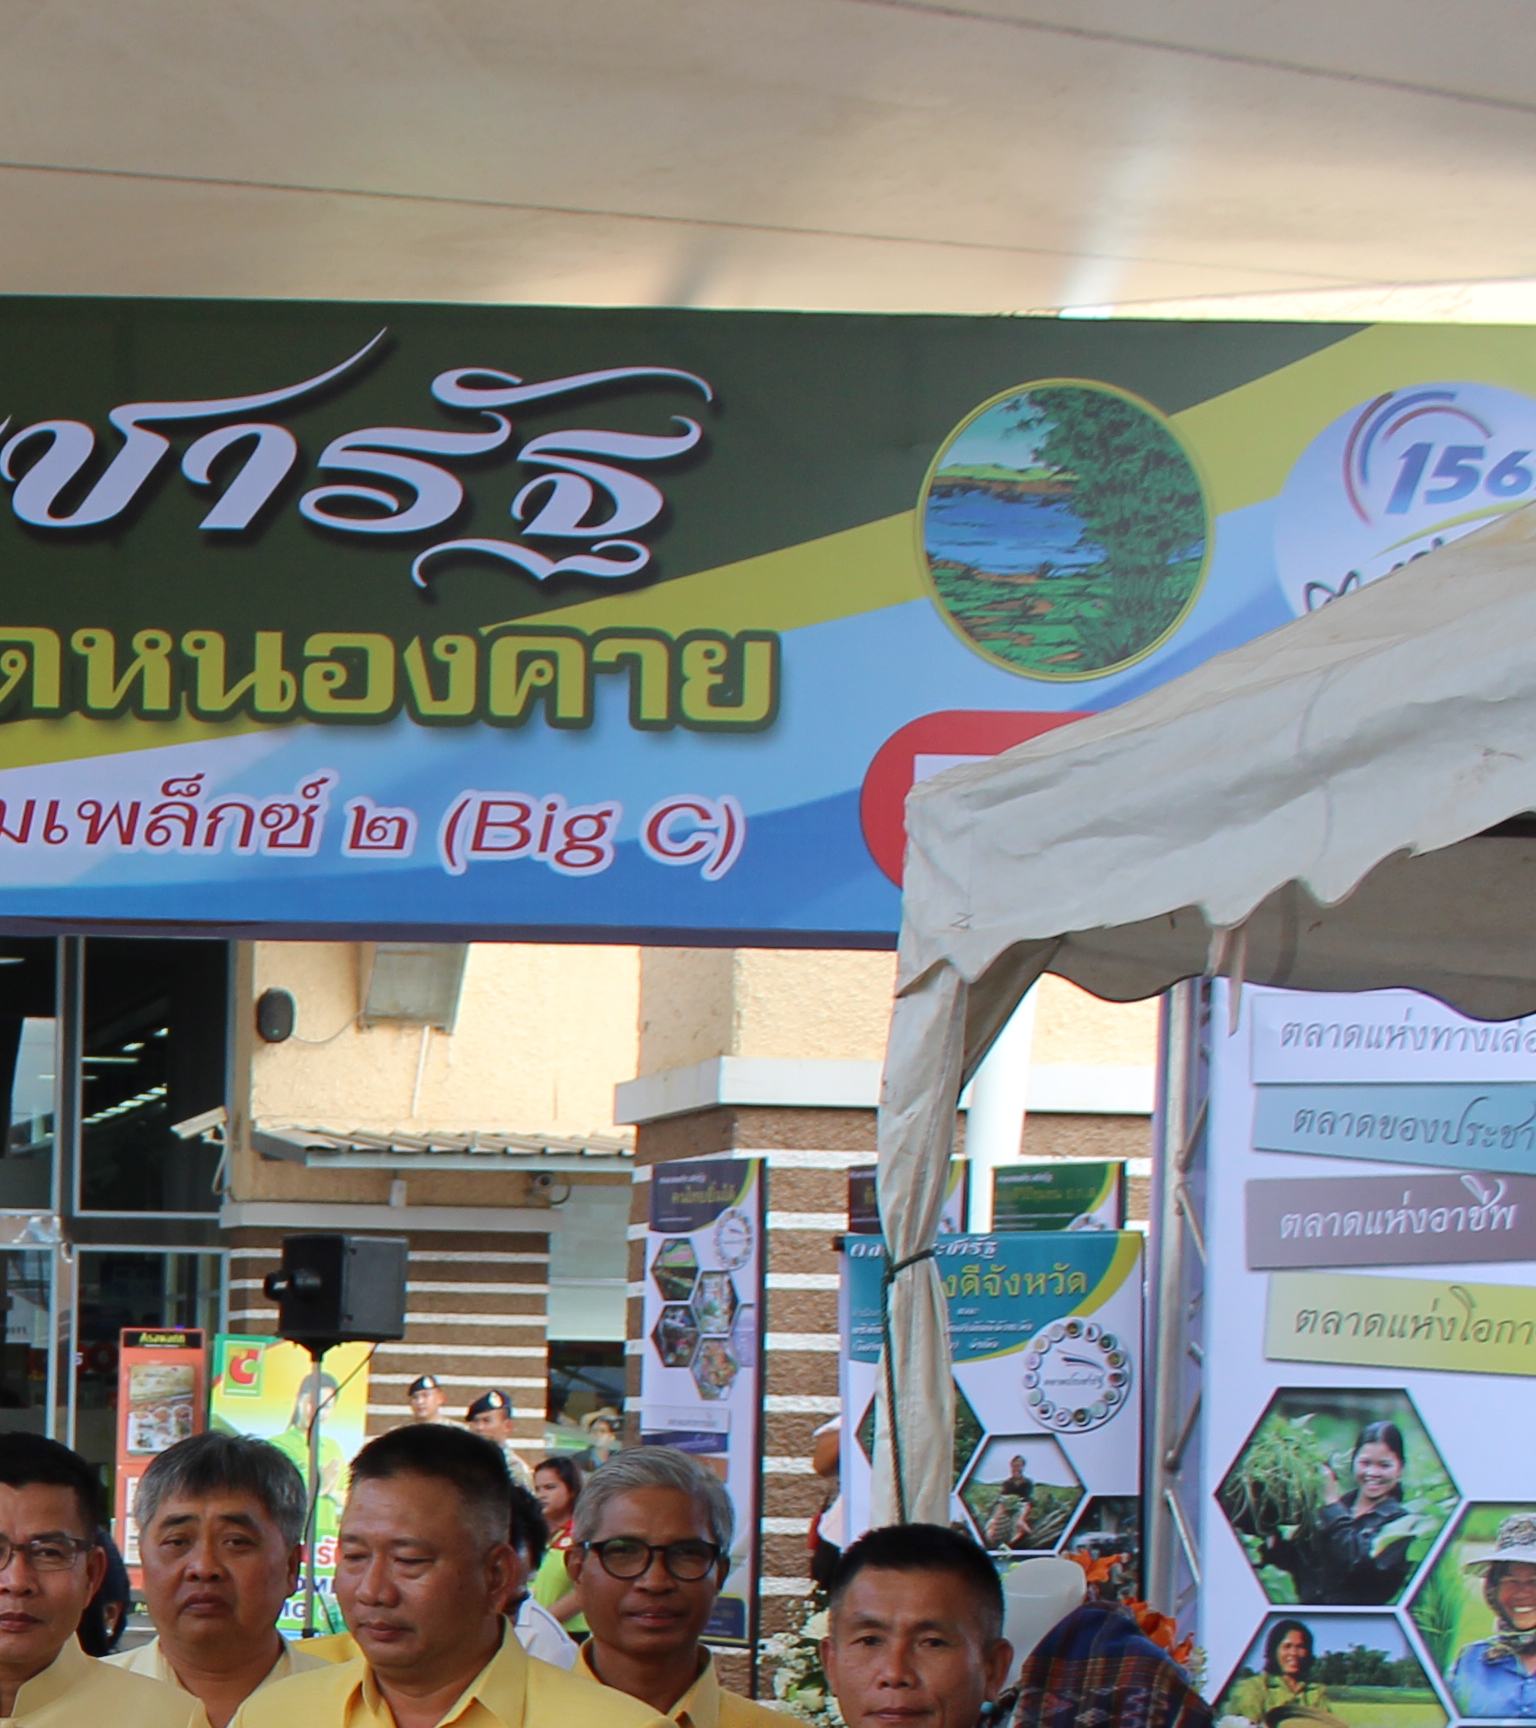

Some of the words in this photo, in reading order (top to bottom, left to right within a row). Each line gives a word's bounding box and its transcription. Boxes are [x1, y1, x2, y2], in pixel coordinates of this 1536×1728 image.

[1385, 441, 1536, 515] 156
[342, 799, 414, 856] ๒
[440, 792, 617, 873] (Big
[642, 795, 746, 880] C)
[1280, 1007, 1536, 1054] ตลาดแห่งทางเลอ
[1293, 1096, 1536, 1151] ตลาดของประชา
[1280, 1174, 1519, 1240] ตลาดแห่งอาชีพ
[940, 1261, 1088, 1298] งดีจังหวัด
[1294, 1285, 1536, 1346] ตลาดแห่งโอกา
